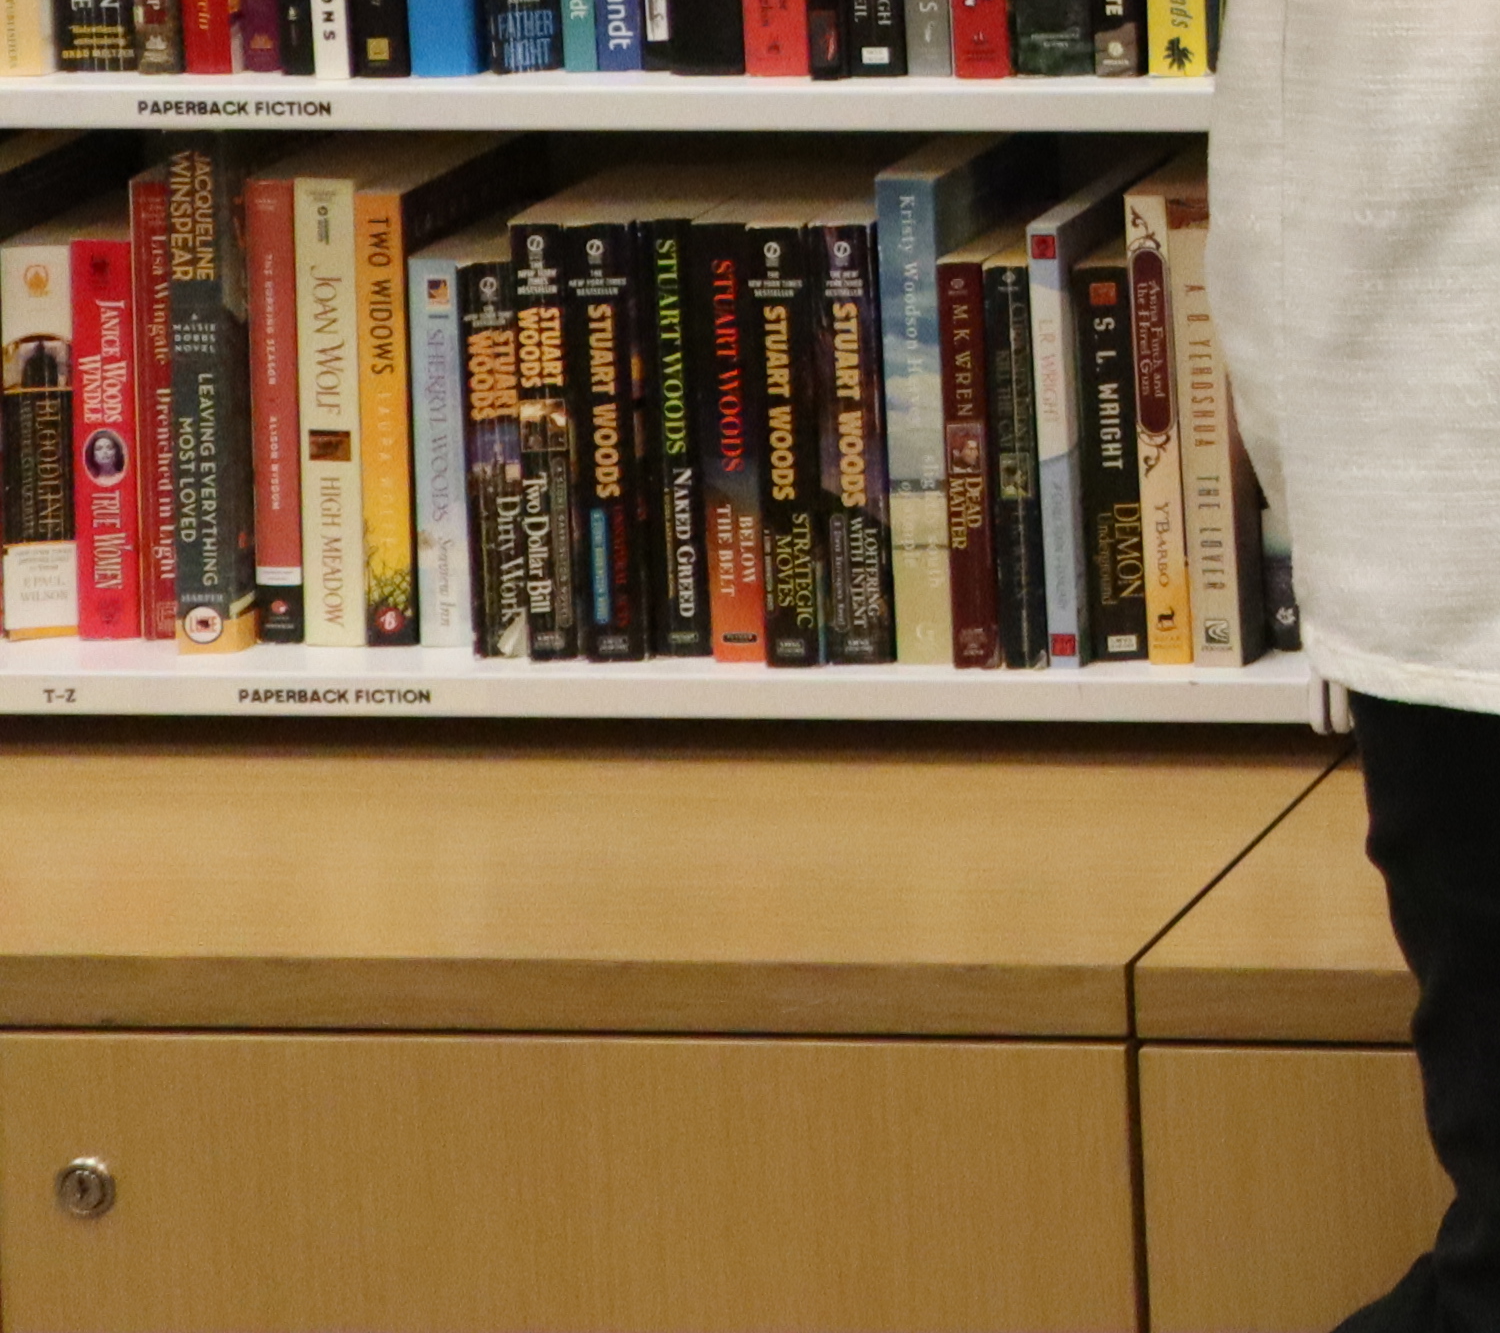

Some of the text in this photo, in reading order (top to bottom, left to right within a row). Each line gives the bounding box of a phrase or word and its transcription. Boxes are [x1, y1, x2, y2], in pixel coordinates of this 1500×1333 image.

[138, 99, 332, 118] PAPERBACK FICTION
[657, 239, 697, 620] STUART WOODS NAKED GREED
[42, 689, 76, 704] T-Z
[238, 687, 431, 705] PAPERBACK FICTION
